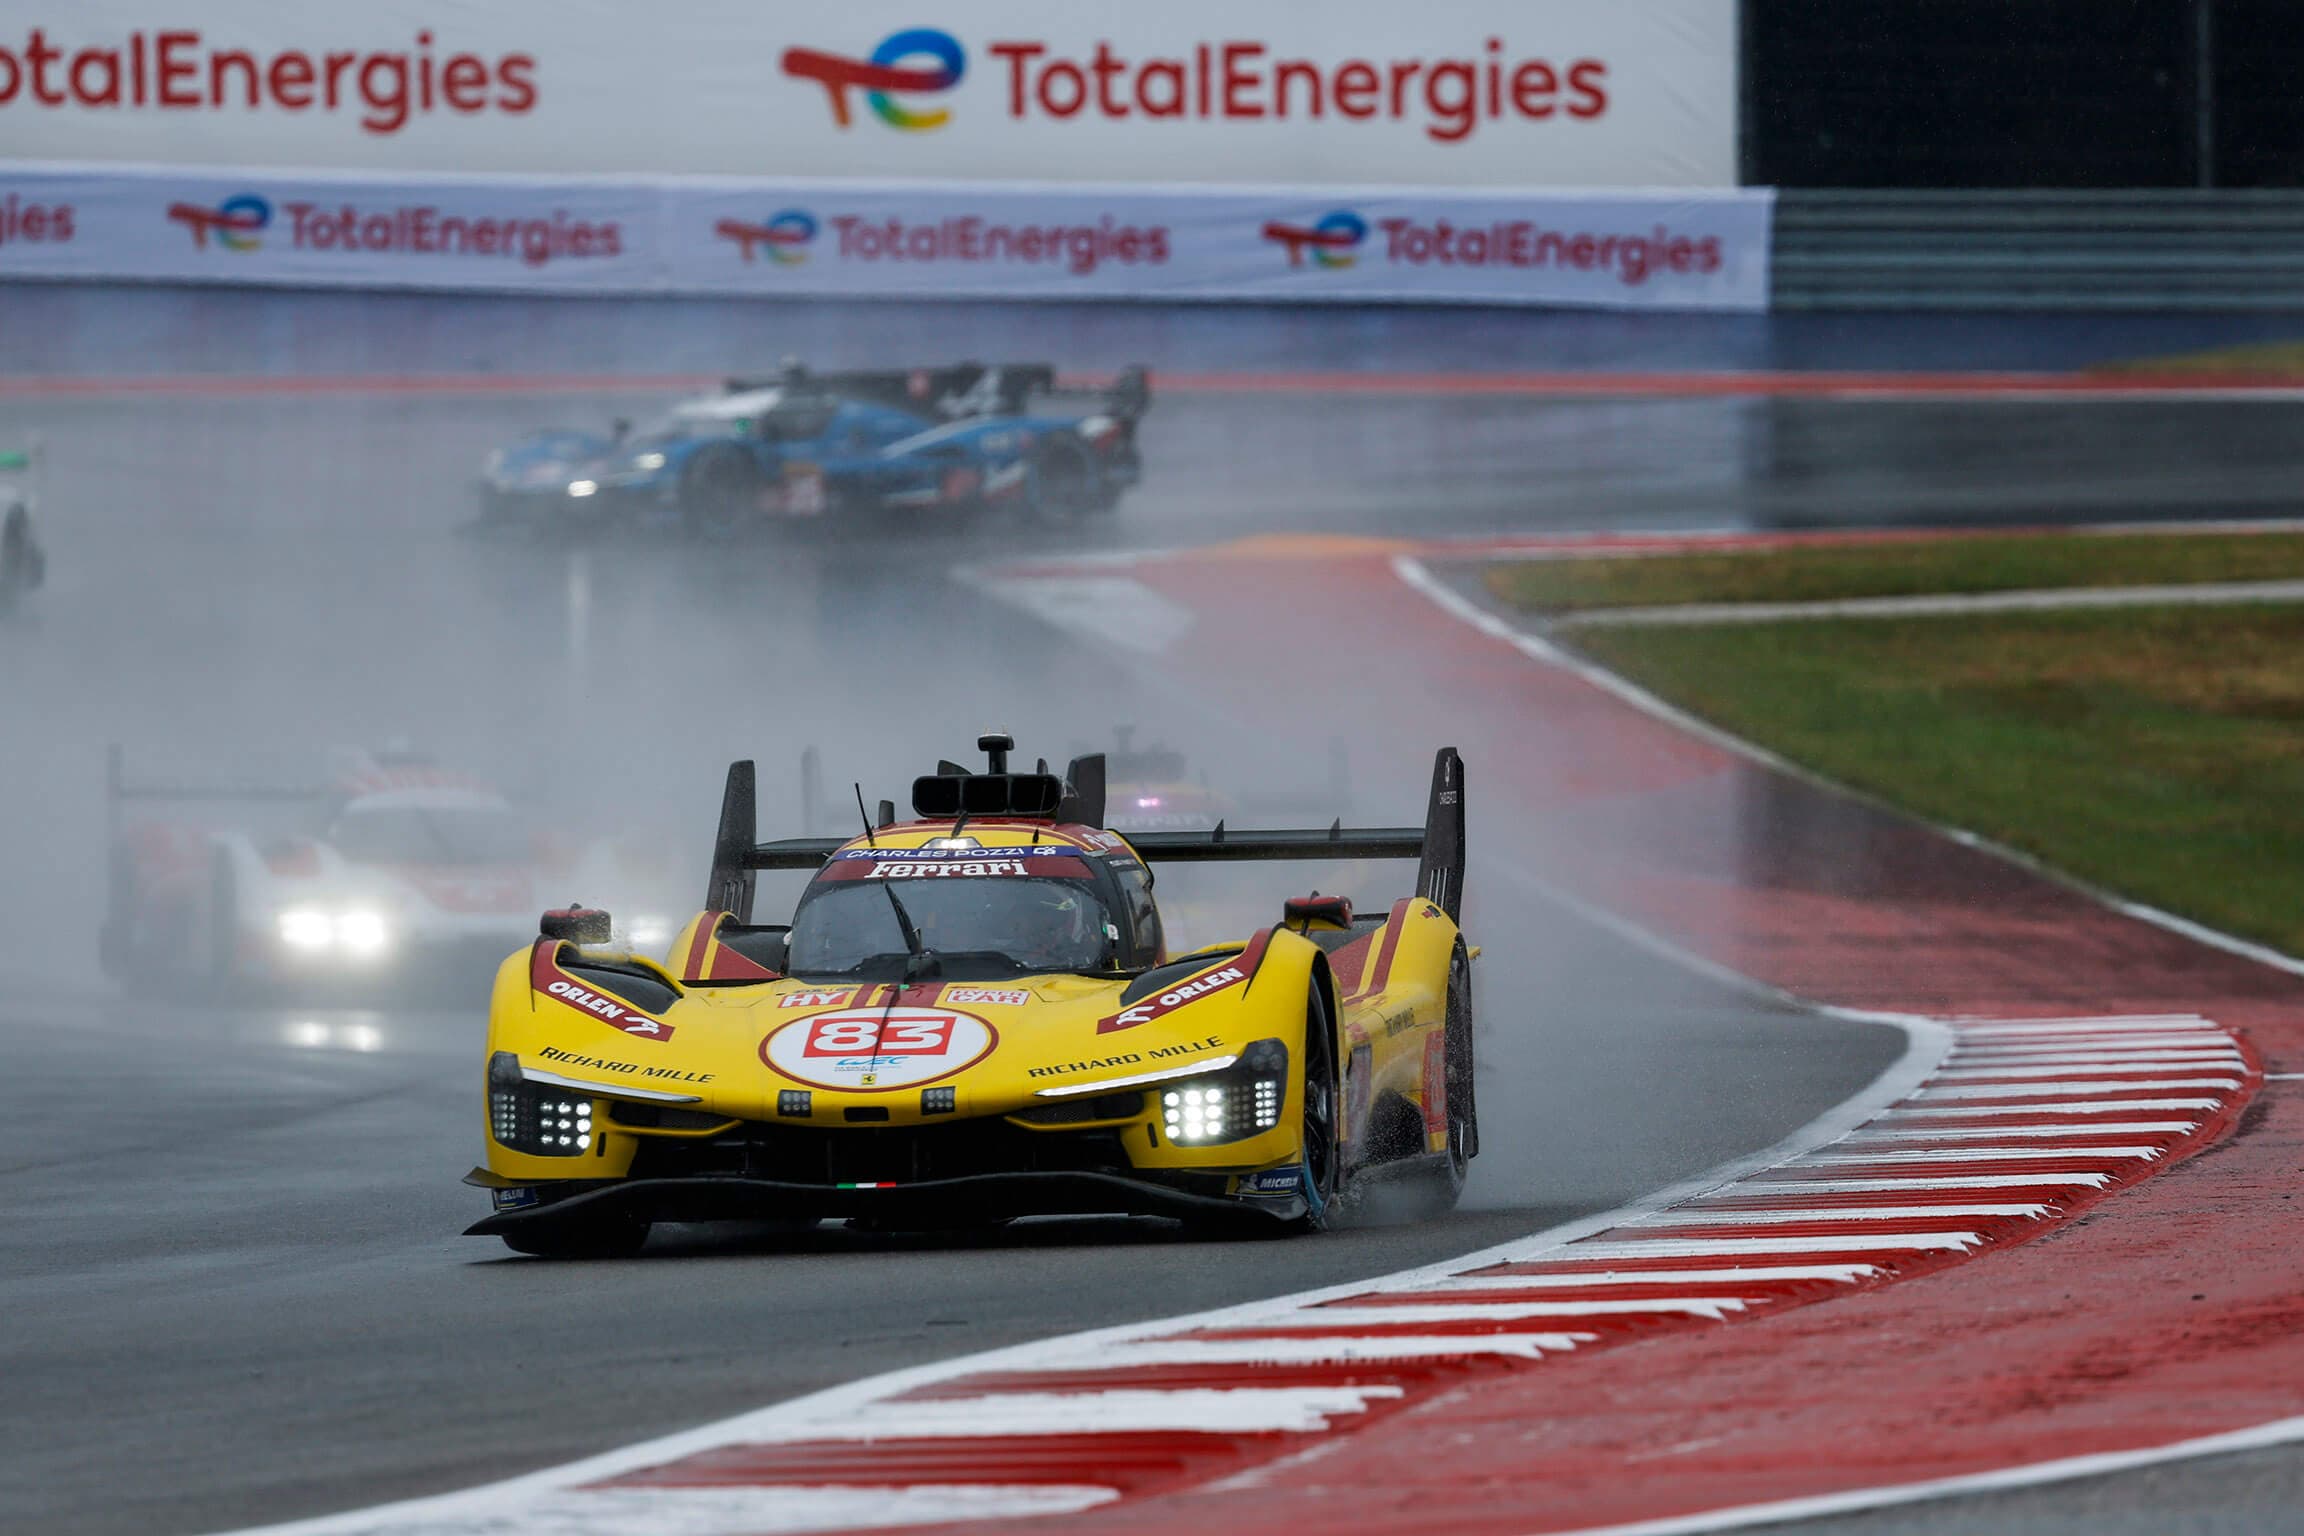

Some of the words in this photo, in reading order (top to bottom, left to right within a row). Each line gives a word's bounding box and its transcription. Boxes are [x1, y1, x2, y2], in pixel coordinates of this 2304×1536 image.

[986, 38, 1610, 142] TotalEnergies
[0, 193, 77, 248] ies
[283, 203, 621, 267] TotalEnergies
[831, 213, 1169, 277] TotalEnergies
[1378, 217, 1722, 286] TotalEnergies
[846, 849, 952, 859] CHARLES
[954, 847, 1025, 857] POZZI
[864, 859, 1029, 879] Ferrari
[548, 981, 625, 1019] ORLEN
[781, 991, 844, 1008] HY
[952, 993, 1020, 1004] CAR
[1159, 967, 1244, 1006] ORLEN
[812, 1020, 946, 1051] 83
[539, 1046, 638, 1074] RICHARD
[641, 1067, 716, 1083] MILLE
[1027, 1053, 1141, 1078] RICHARD
[1148, 1035, 1225, 1059] MILLE
